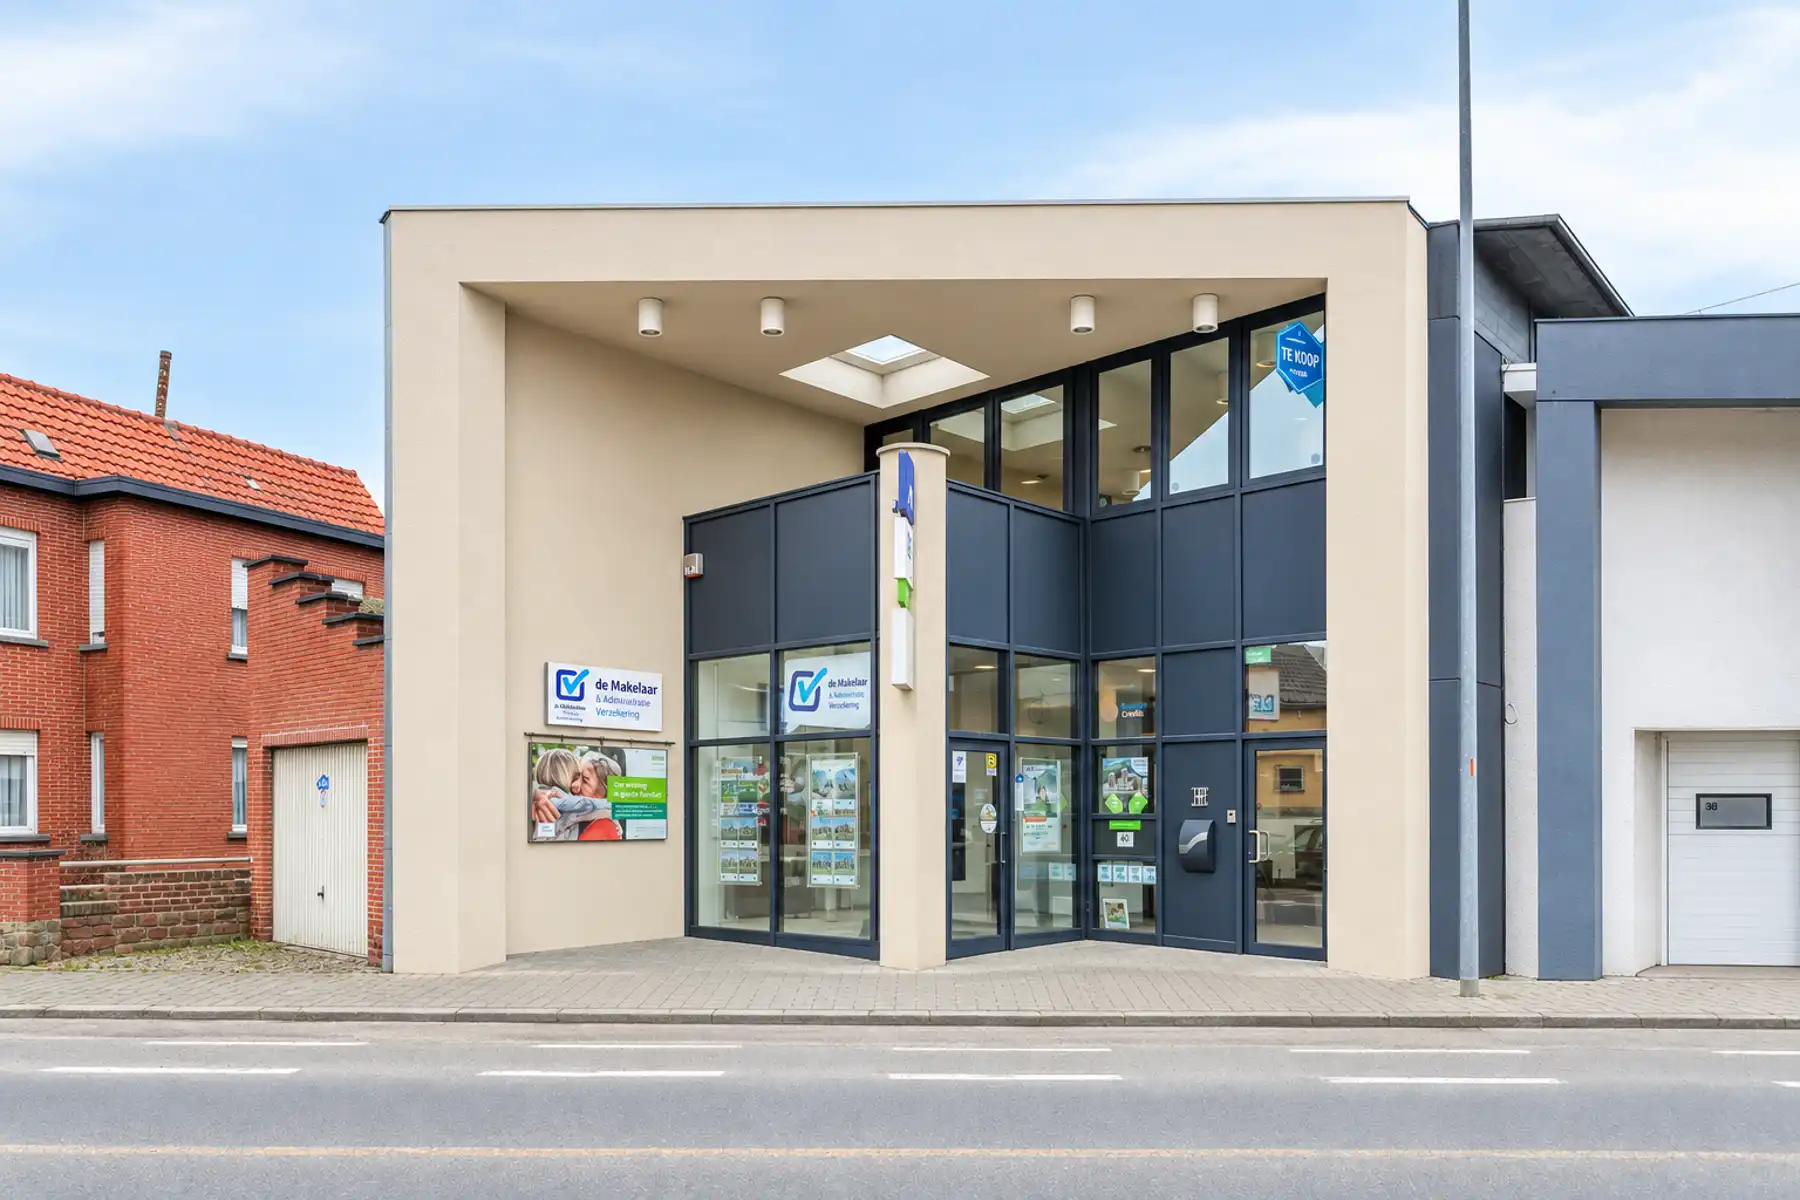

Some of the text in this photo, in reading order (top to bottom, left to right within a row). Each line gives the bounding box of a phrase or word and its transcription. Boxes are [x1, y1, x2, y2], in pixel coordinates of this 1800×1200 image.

[1281, 346, 1320, 368] TE KOOP
[595, 678, 658, 695] de Makelaar
[828, 679, 837, 688] de
[1705, 802, 1718, 811] 38
